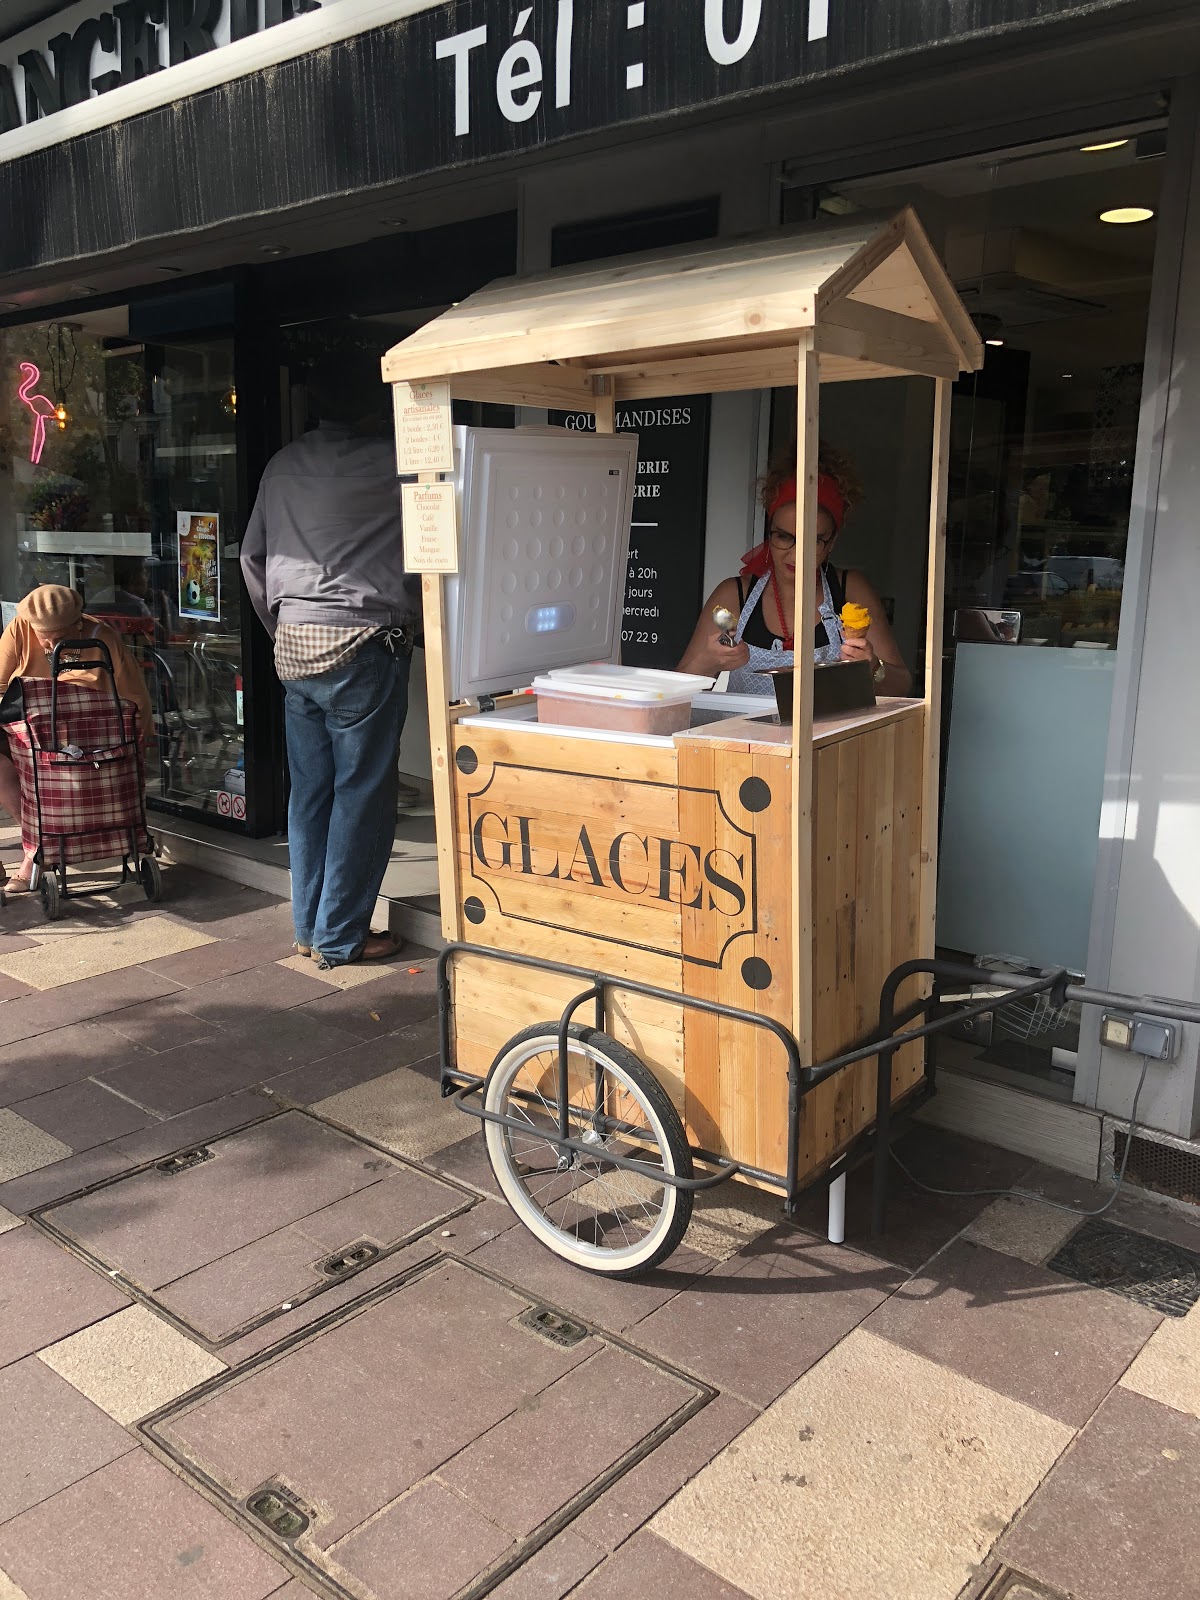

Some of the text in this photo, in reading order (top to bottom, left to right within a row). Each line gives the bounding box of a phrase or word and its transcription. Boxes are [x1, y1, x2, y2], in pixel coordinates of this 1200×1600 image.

[435, 0, 573, 137] Tél
[409, 390, 433, 400] Glaces
[404, 403, 440, 414] artisanales
[565, 407, 691, 430] GOUANDISES
[407, 425, 422, 433] boule
[410, 435, 428, 443] boules
[637, 461, 669, 474] ERIE
[413, 491, 442, 500] Parfums
[416, 503, 440, 511] Chocolat
[421, 535, 438, 543] Fraise
[629, 567, 657, 579] à 20h
[628, 586, 653, 598] jours
[622, 606, 660, 617] ercredi
[636, 631, 648, 643] 22
[473, 811, 746, 917] GLACES
